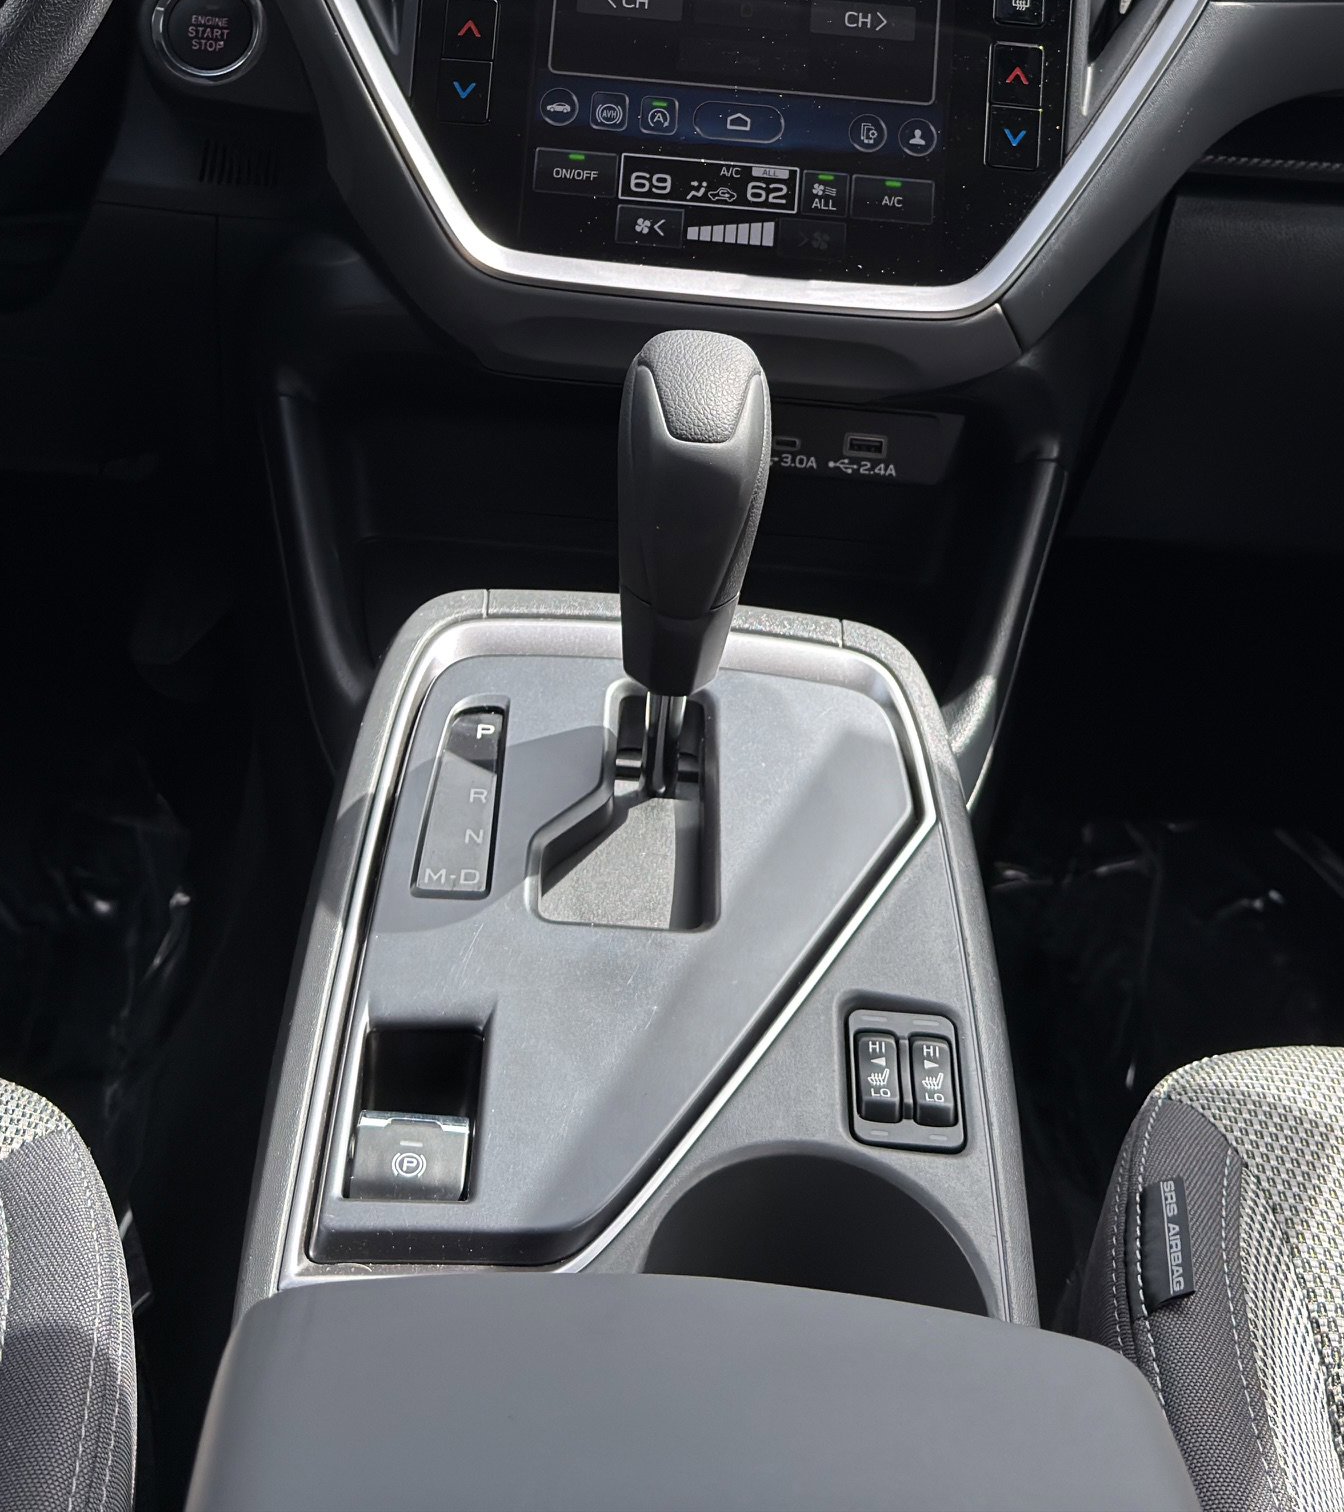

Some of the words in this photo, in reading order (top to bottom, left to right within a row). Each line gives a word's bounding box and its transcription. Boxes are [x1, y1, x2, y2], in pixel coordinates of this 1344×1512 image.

[191, 15, 229, 27] ENGINE
[188, 26, 230, 40] START
[191, 39, 225, 51] STOP
[552, 166, 598, 180] ON/OFF
[720, 166, 741, 179] A/C
[761, 168, 779, 178] ALL
[629, 172, 672, 194] 69
[746, 181, 787, 205] 62
[812, 198, 837, 211] ALL
[881, 195, 903, 208] A/C
[780, 454, 817, 470] 3.0A
[859, 462, 896, 477] 2.4A
[476, 724, 495, 739] P
[469, 789, 487, 804] R
[464, 828, 484, 845] N
[869, 1041, 886, 1055] HI
[923, 1044, 940, 1059] HI
[871, 1088, 891, 1098] LO
[925, 1092, 945, 1103] LO
[1163, 1180, 1179, 1217] SRS
[1167, 1222, 1185, 1292] AIRBAG
